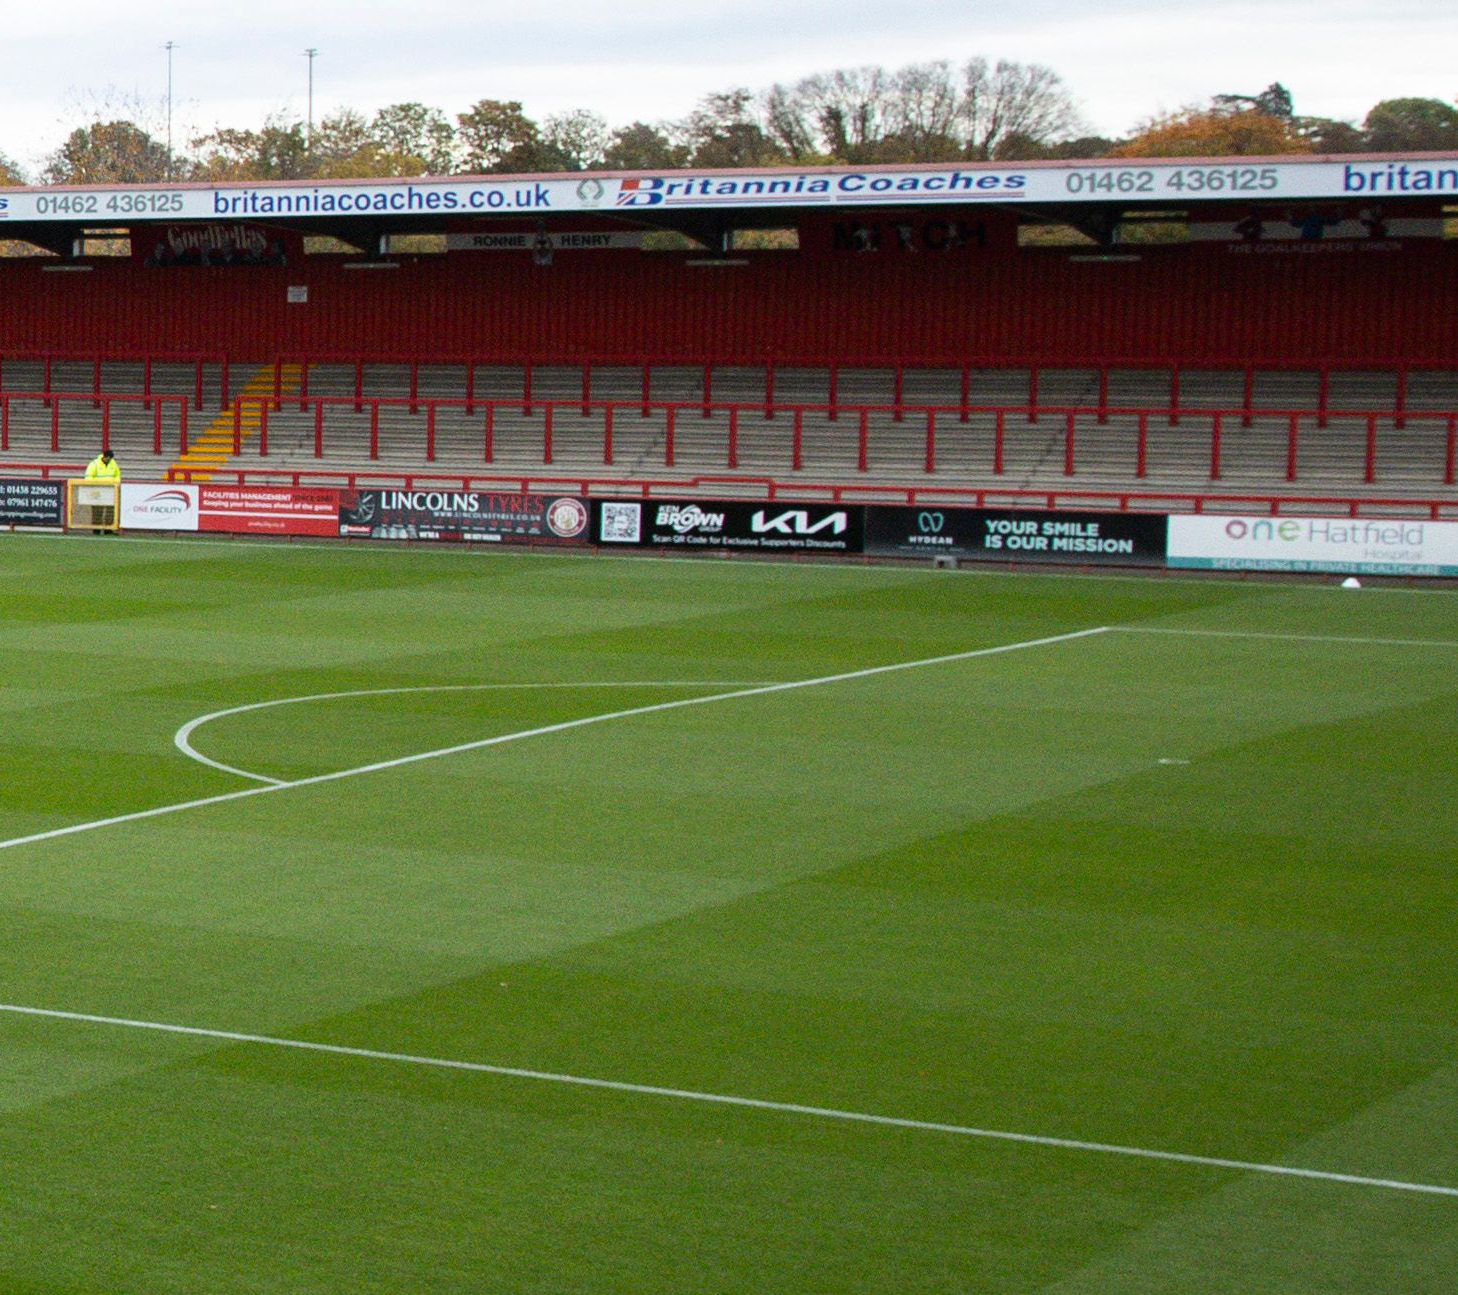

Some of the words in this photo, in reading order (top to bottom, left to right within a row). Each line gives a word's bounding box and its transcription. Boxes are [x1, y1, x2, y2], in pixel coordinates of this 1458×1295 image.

[616, 177, 828, 206] Britannia
[838, 172, 1025, 192] Coaches
[1065, 171, 1154, 193] 01462
[1166, 168, 1279, 191] 436125
[36, 195, 97, 214] 01462
[106, 193, 183, 212] 436125
[214, 184, 551, 215] britanniacoaches.co.uk
[473, 236, 525, 247] RONNIE
[561, 234, 611, 246] HENRY
[381, 491, 480, 515] LINCOLNS
[656, 511, 725, 528] BROWN
[752, 509, 847, 534] KIA
[985, 519, 1039, 536] YOUR
[1042, 521, 1099, 537] SMILE
[1225, 519, 1301, 542] one
[1307, 520, 1425, 546] Hatfield
[985, 533, 1003, 550] IS
[1006, 534, 1049, 551] OUR
[1052, 536, 1133, 554] MISSION
